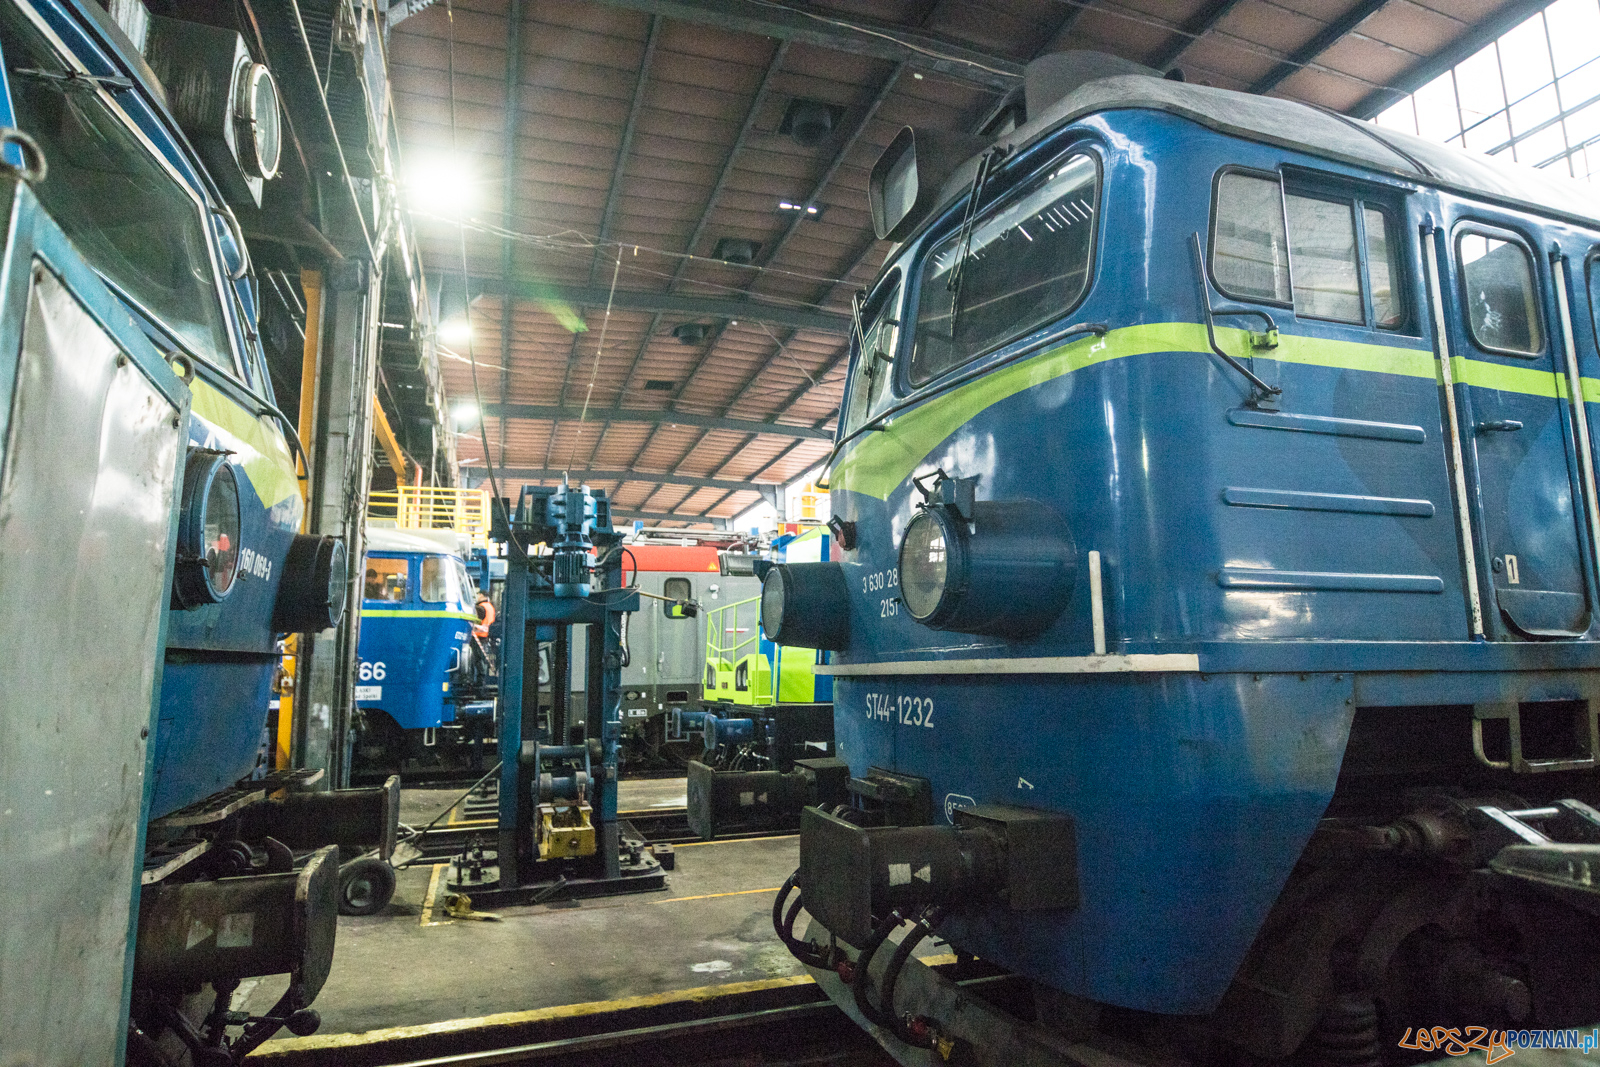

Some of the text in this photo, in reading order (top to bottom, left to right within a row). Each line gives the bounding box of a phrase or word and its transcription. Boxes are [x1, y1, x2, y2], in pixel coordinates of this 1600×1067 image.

[240, 547, 272, 582] 160 069-3
[1508, 558, 1516, 580] 1
[862, 567, 899, 594] 3 630 28
[359, 661, 386, 681] 66
[866, 692, 934, 729] ST44-1232
